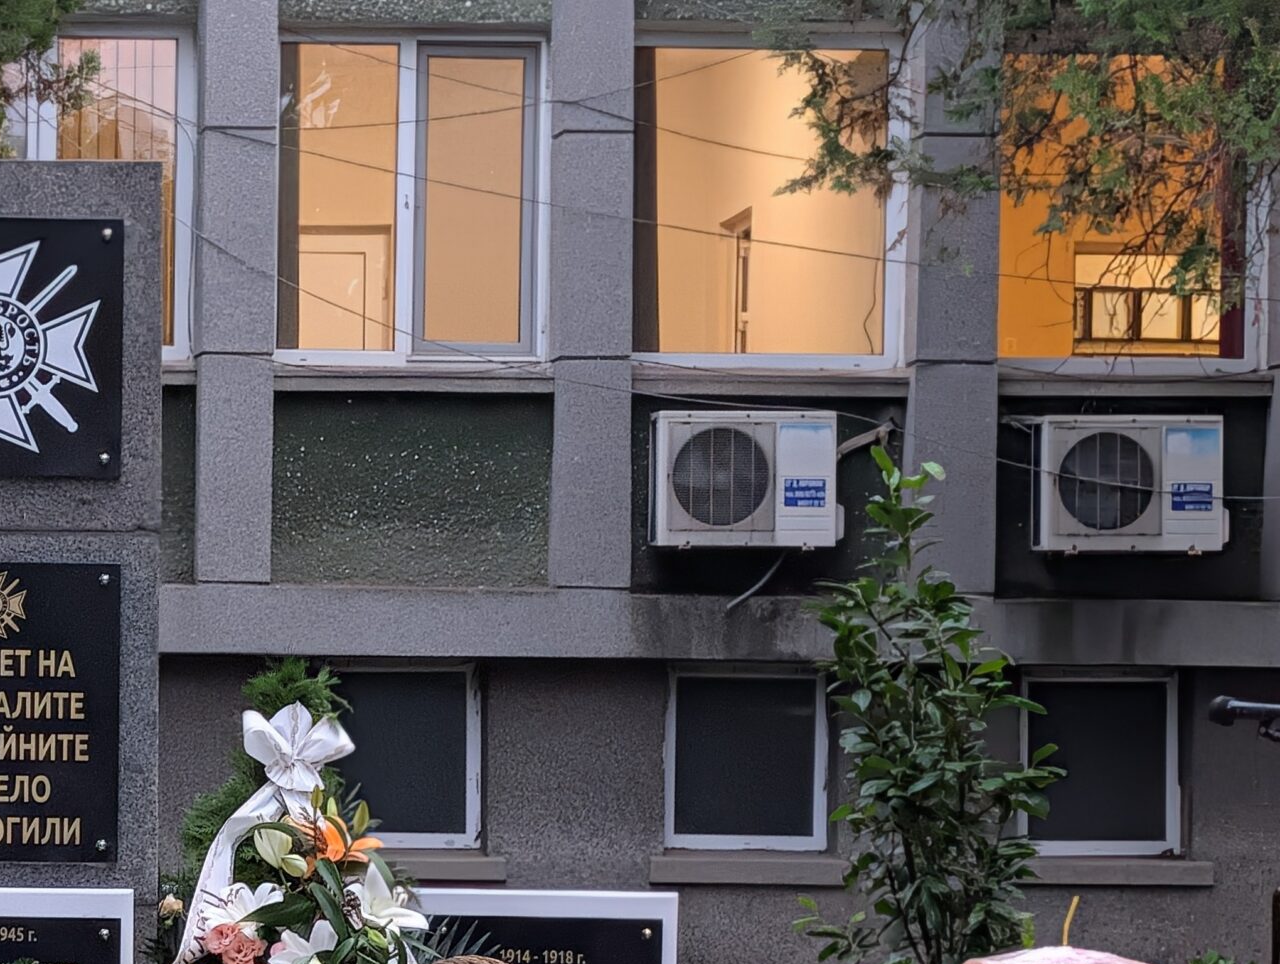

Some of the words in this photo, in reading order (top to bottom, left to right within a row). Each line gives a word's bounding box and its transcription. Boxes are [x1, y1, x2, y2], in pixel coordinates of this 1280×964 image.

[38, 650, 76, 678] НА
[28, 929, 37, 941] г.
[500, 949, 529, 963] 1914
[543, 950, 573, 964] 1918
[577, 952, 586, 964] г.
